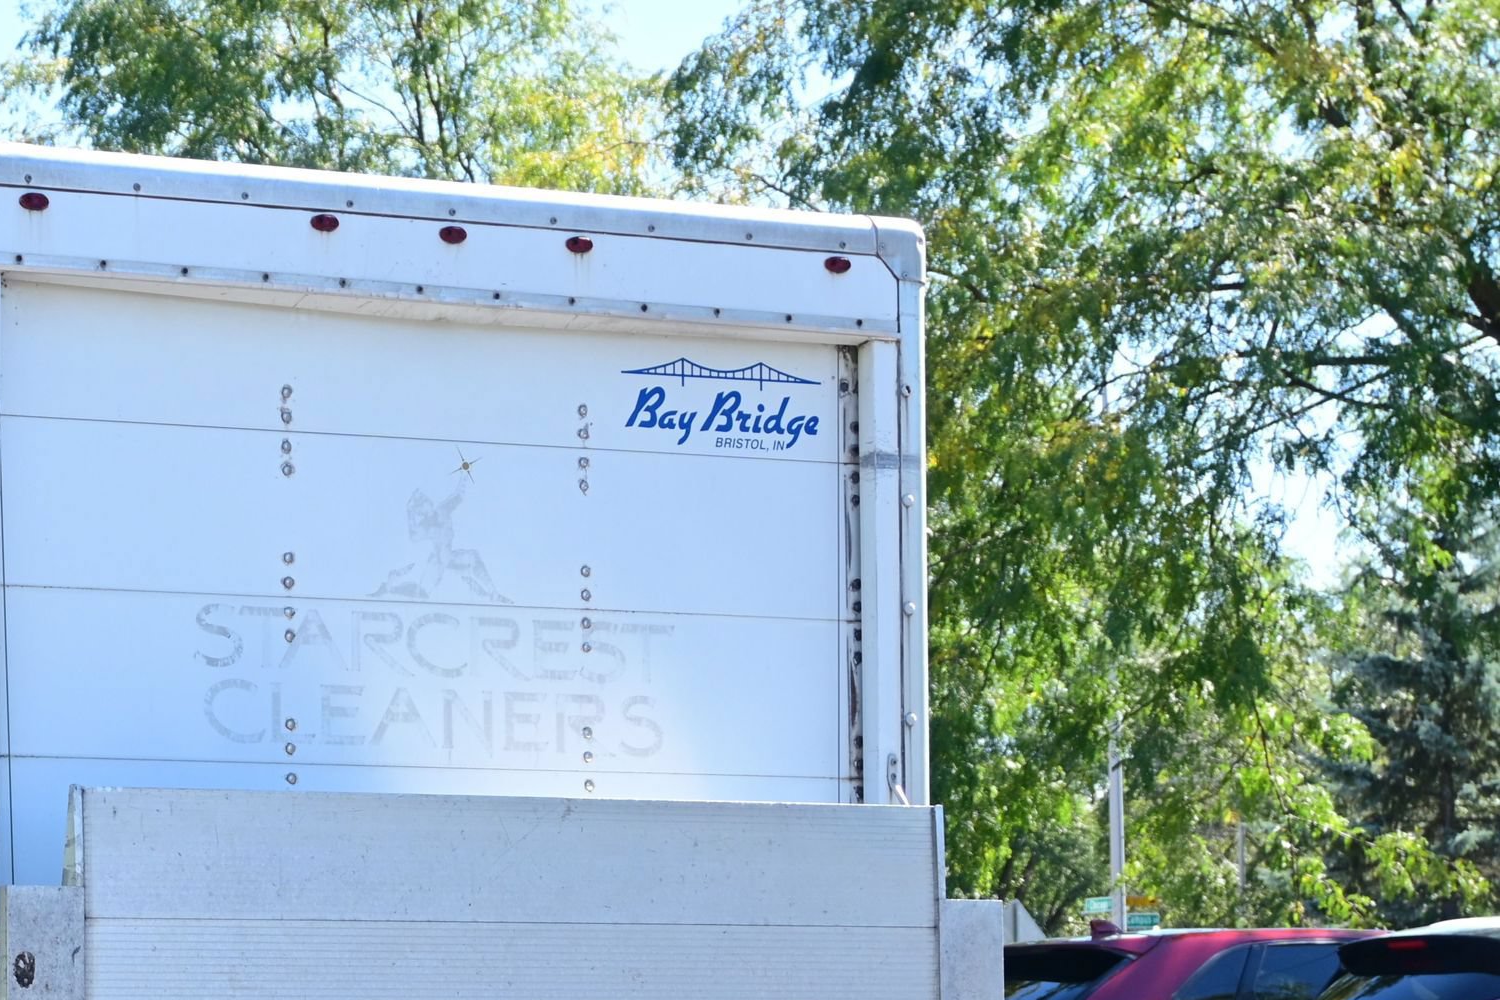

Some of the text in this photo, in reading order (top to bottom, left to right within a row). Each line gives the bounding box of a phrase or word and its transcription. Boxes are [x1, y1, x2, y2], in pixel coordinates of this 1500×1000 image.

[625, 386, 820, 449] Bay Bridge
[715, 437, 785, 452] BRISTOL, IN
[194, 602, 676, 684] STARCREST
[202, 678, 664, 759] CLEANERS
